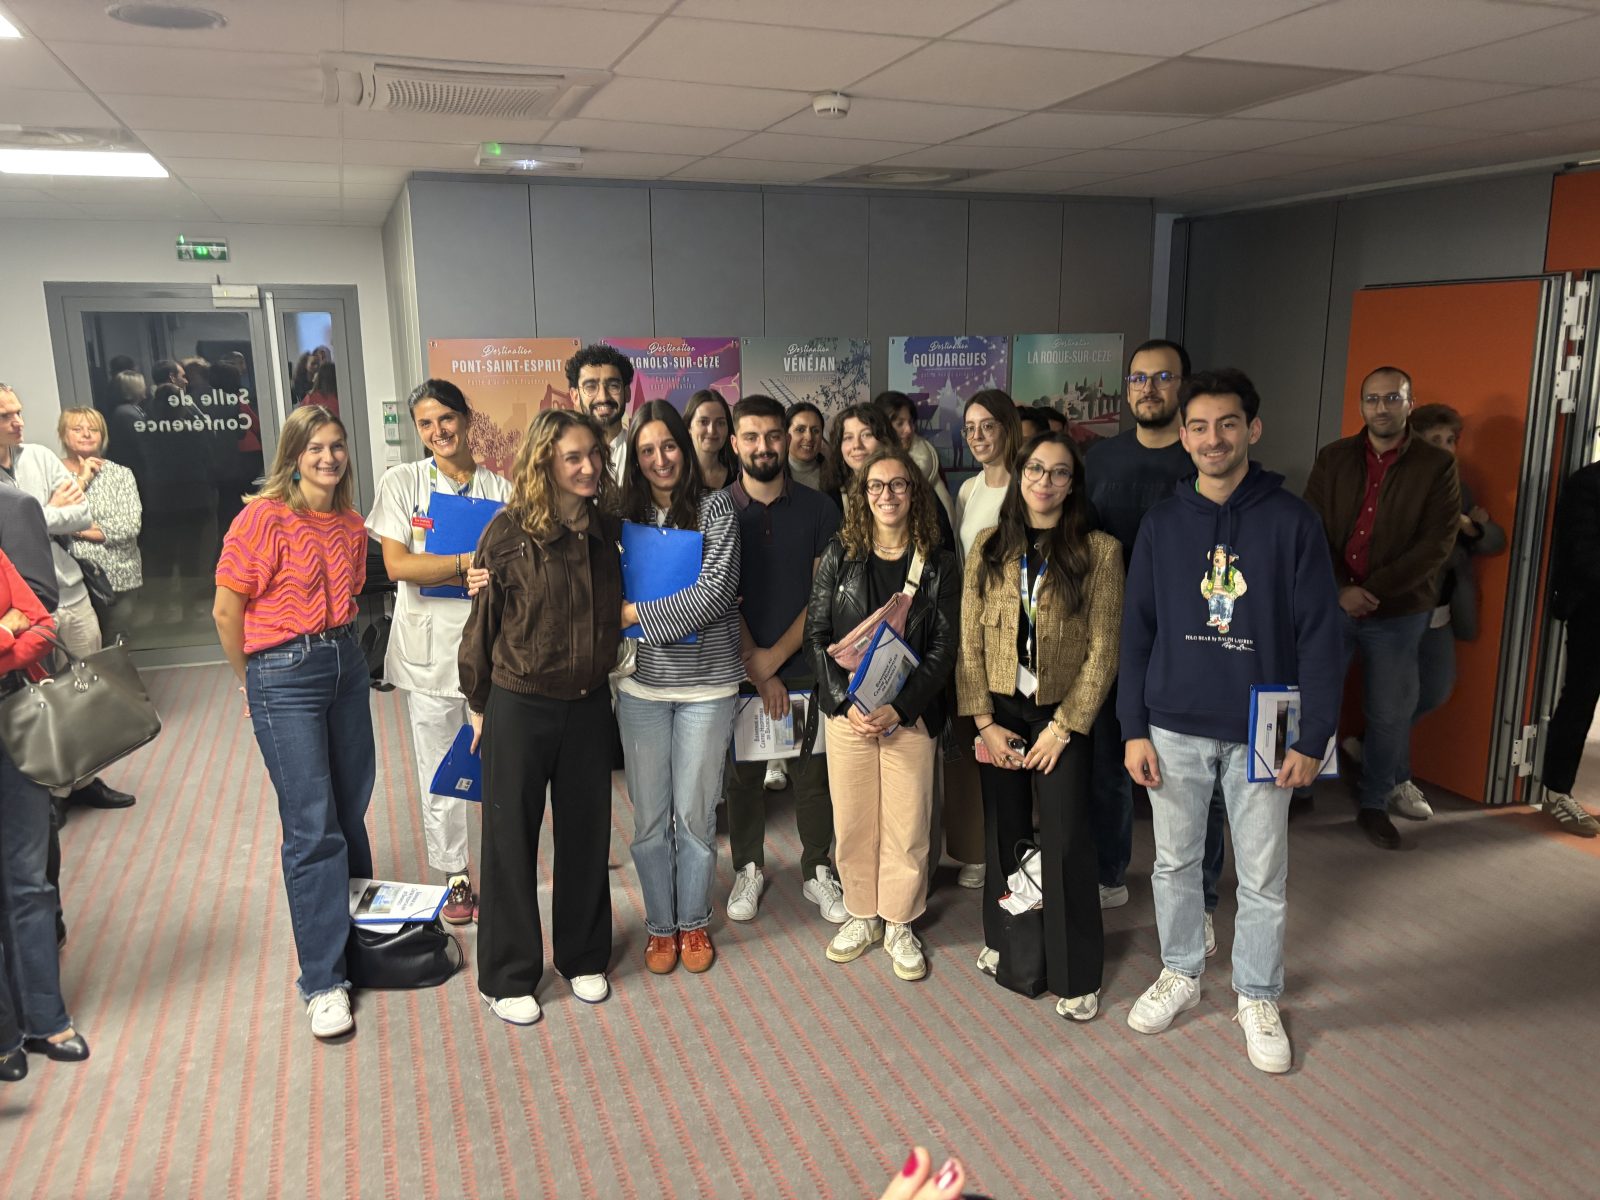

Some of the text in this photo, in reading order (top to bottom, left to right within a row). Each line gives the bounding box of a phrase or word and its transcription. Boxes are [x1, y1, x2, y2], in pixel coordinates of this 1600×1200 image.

[481, 344, 533, 357] Destination
[646, 341, 696, 355] Destination
[786, 343, 830, 355] Destination
[928, 340, 969, 352] Destination
[629, 354, 720, 369] AGNOLS-SUR-CÈZE
[783, 354, 836, 372] VÉNÉJAN
[912, 352, 987, 368] GOUDARGUES
[1027, 351, 1039, 364] LA
[452, 359, 561, 373] PONT-SAINT-ESPRIT
